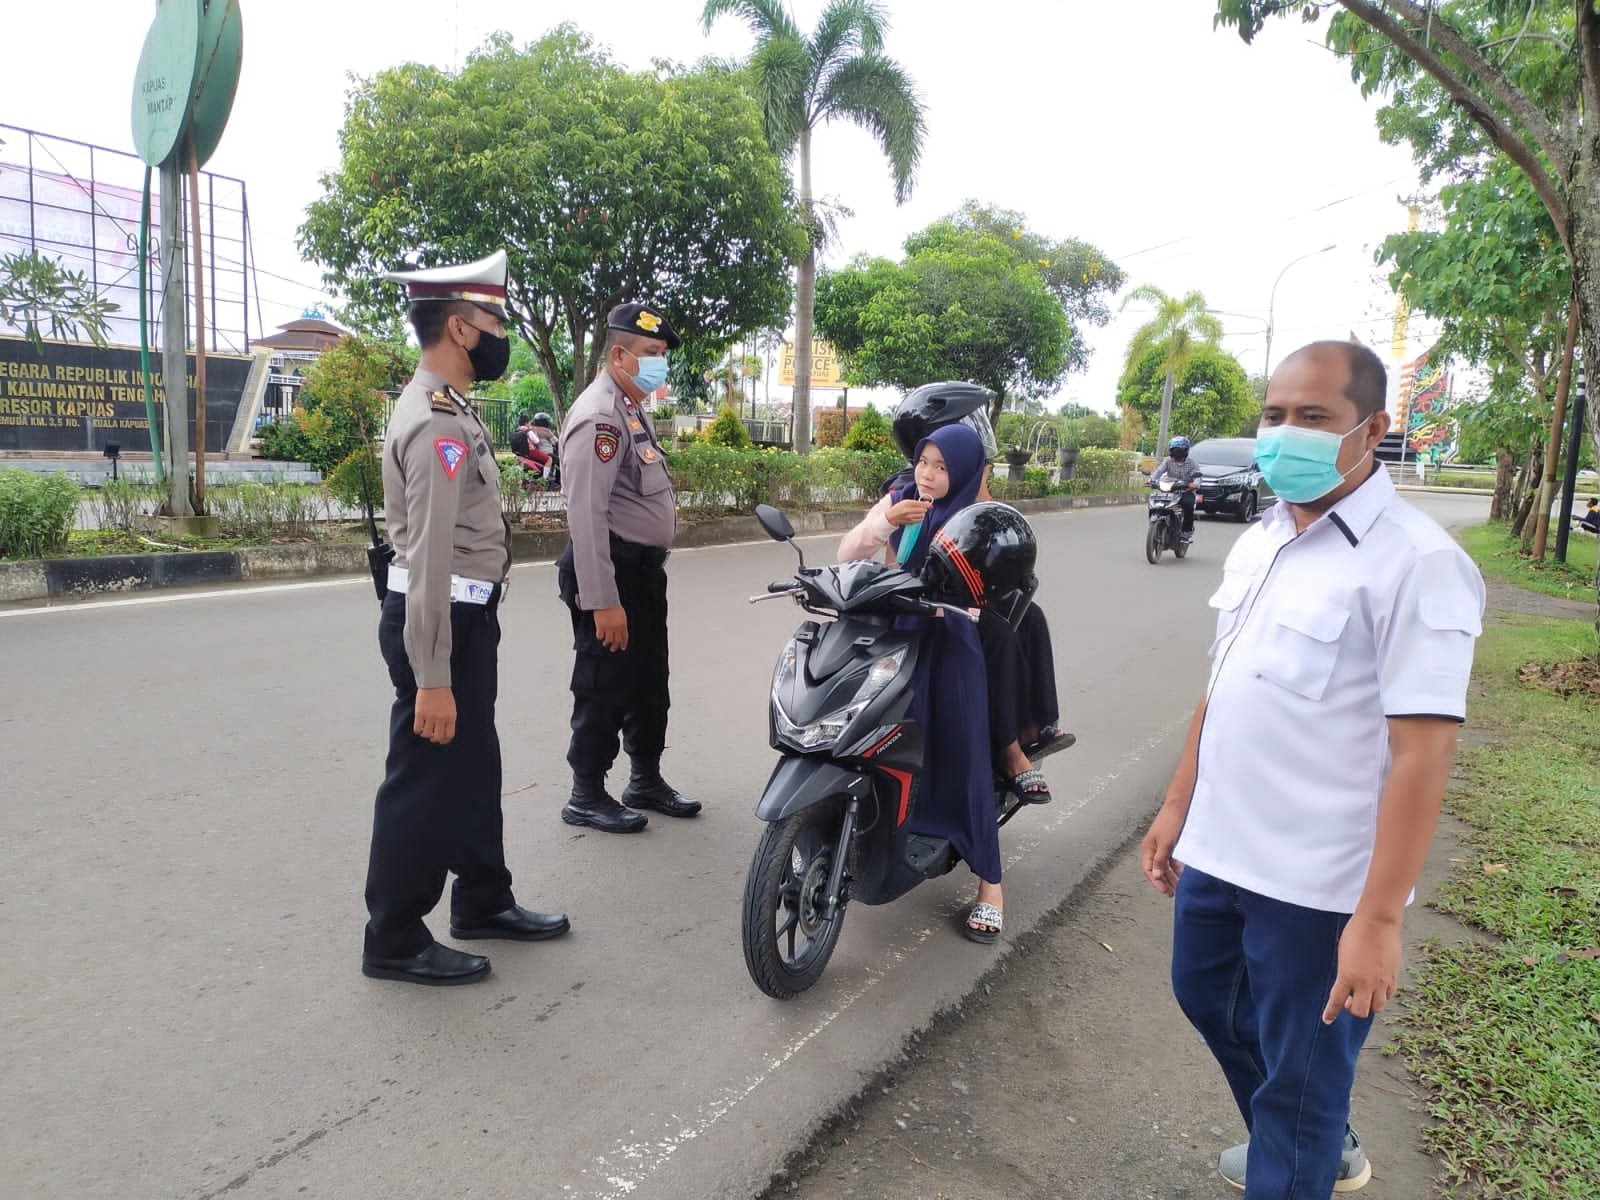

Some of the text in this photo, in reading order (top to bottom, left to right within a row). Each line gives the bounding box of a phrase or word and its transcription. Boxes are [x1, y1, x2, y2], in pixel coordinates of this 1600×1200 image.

[0, 361, 51, 379] EGARA
[55, 365, 127, 385] REPUBLIK
[8, 381, 105, 400] KALIMANTAN
[110, 386, 164, 403] TENGH
[0, 398, 114, 417] RESOR KAPUAS
